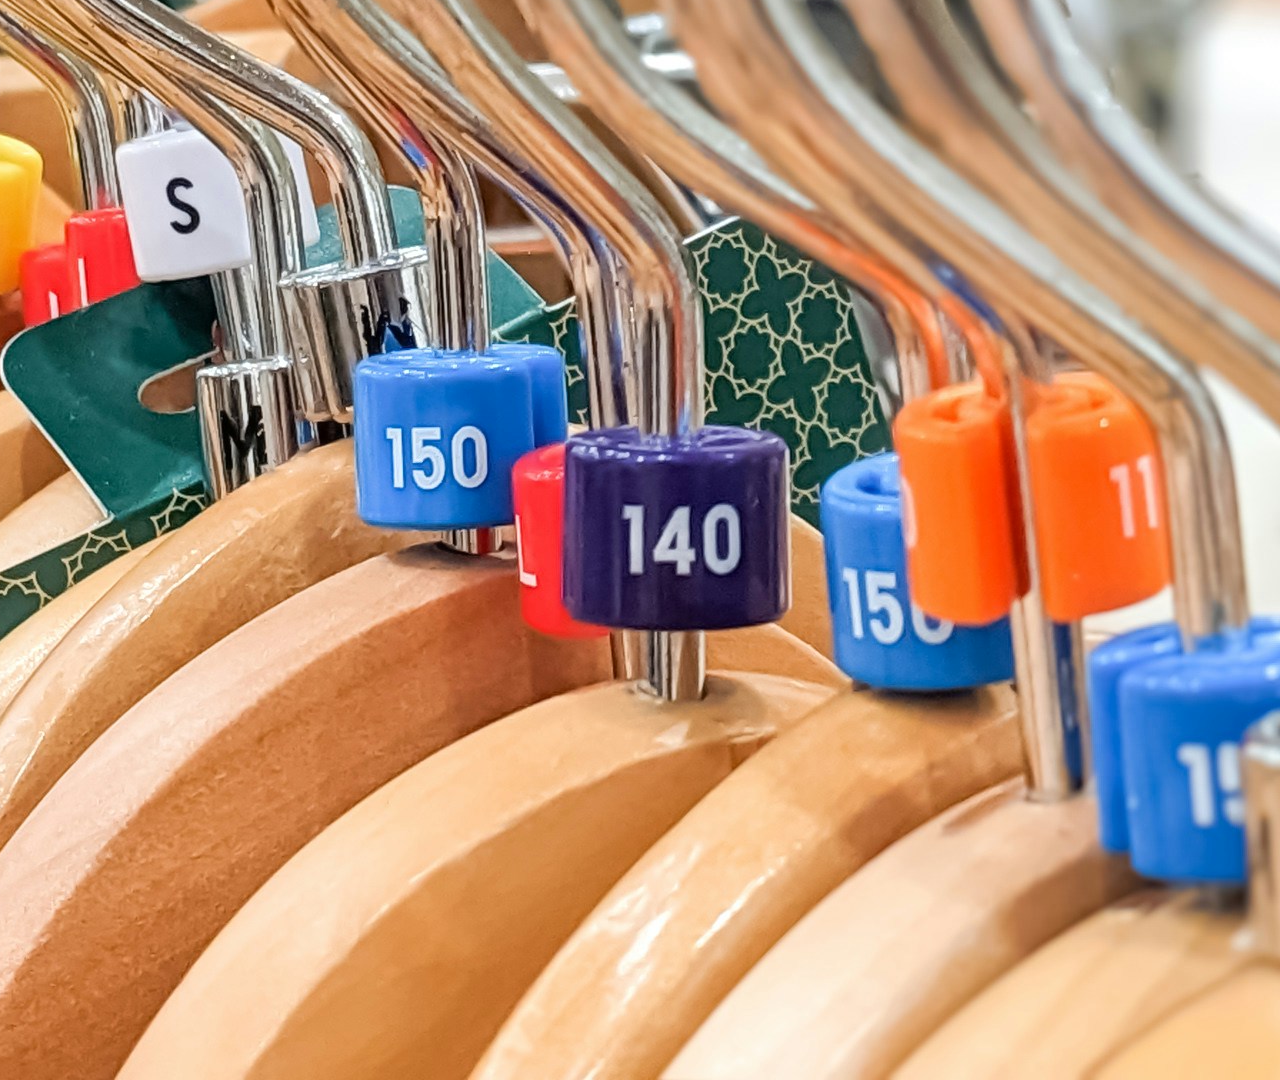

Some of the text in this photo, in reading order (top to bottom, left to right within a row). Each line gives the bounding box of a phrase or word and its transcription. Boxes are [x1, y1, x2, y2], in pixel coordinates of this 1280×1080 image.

[166, 176, 201, 235] S
[385, 425, 489, 491] 150
[622, 503, 742, 577] 140
